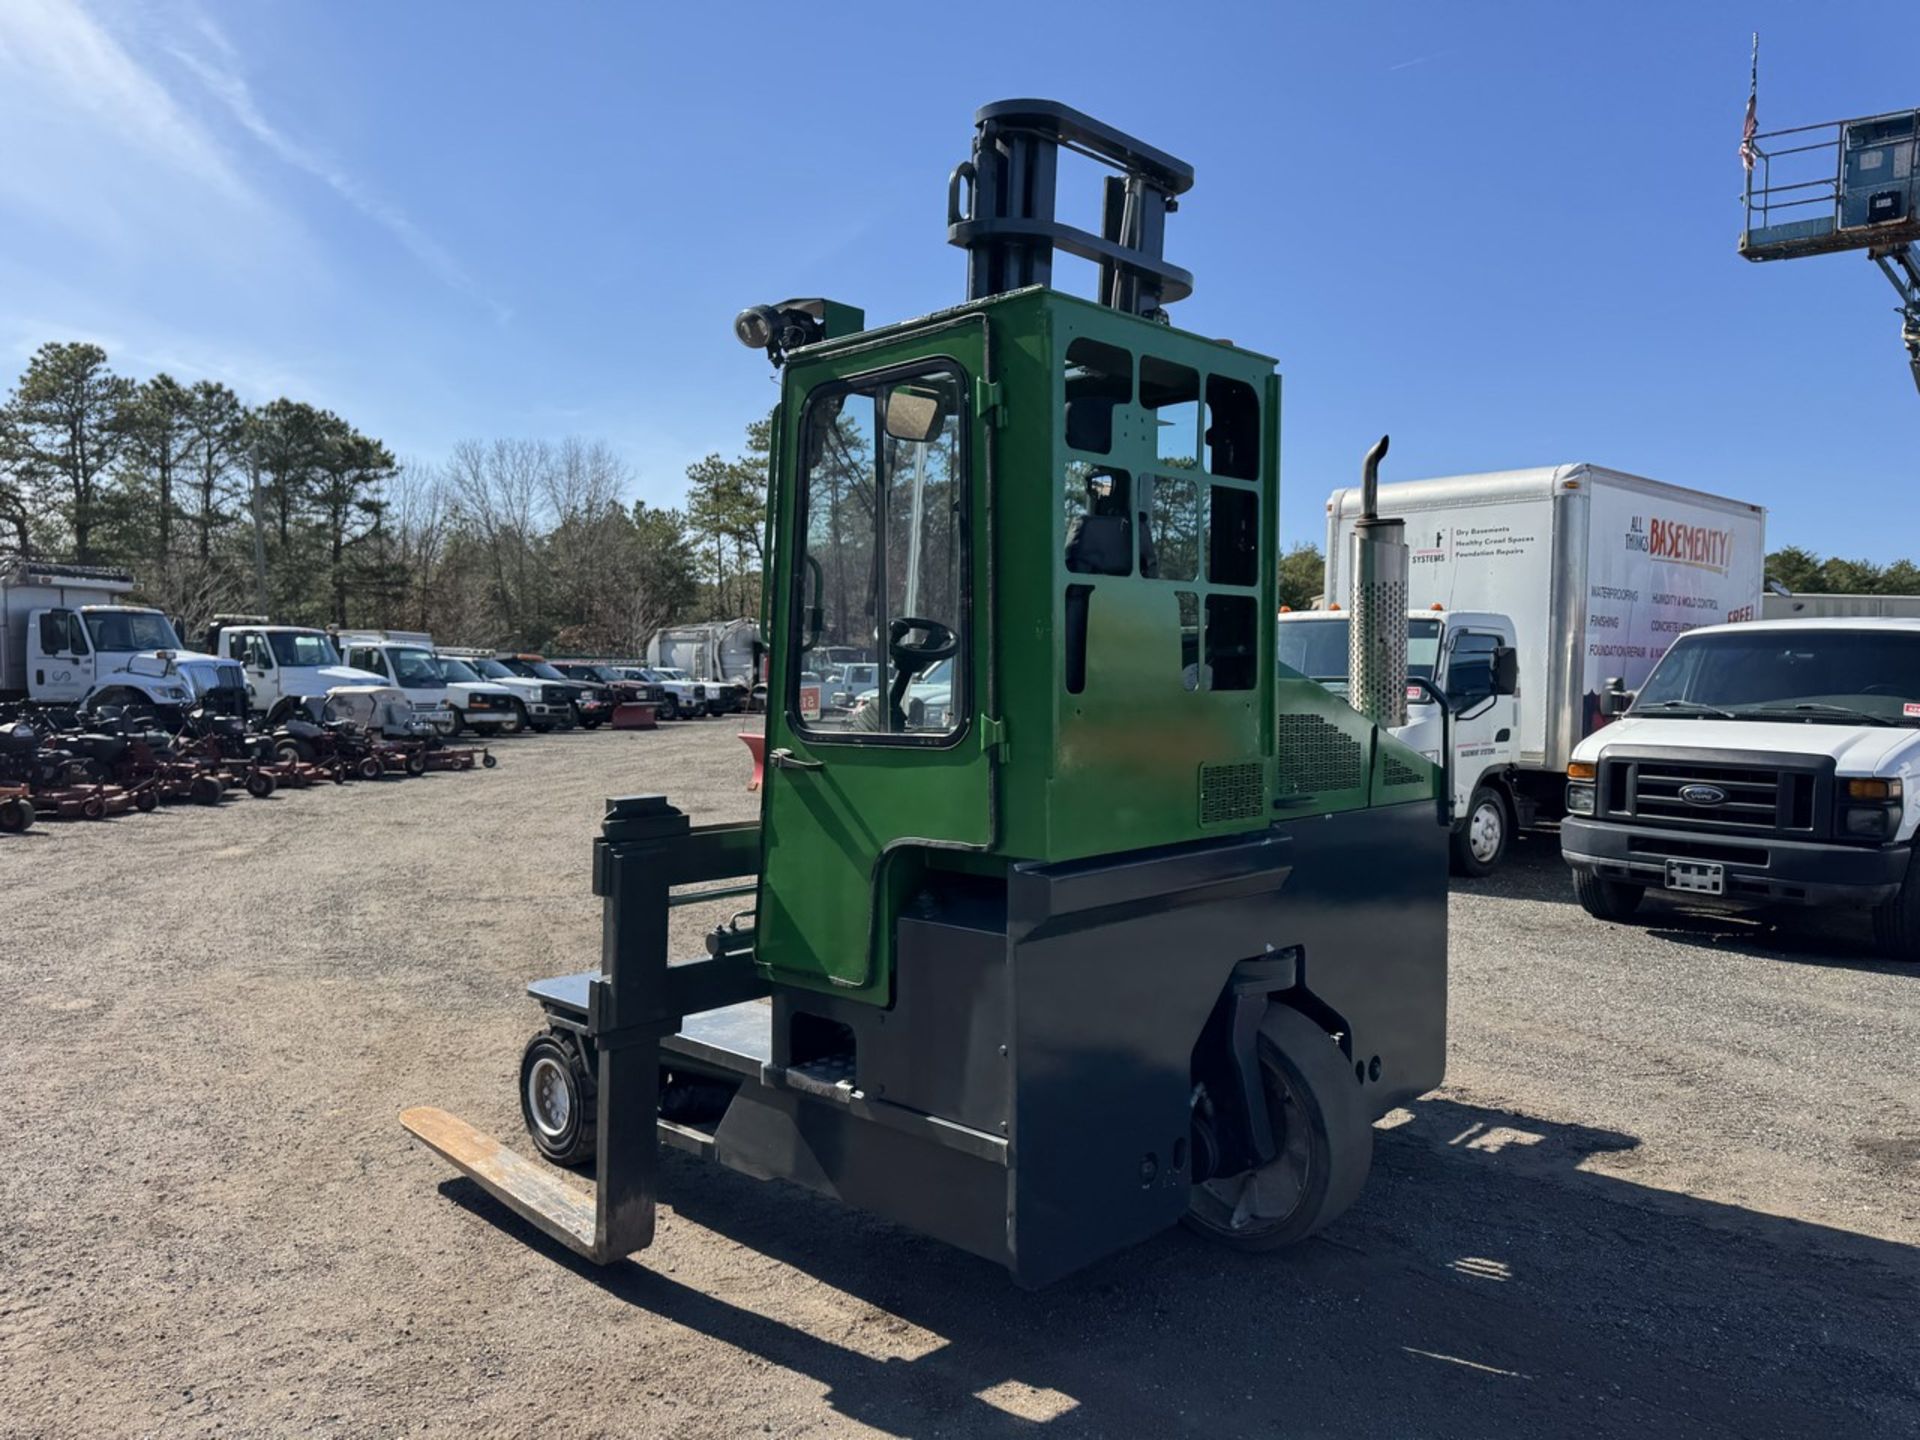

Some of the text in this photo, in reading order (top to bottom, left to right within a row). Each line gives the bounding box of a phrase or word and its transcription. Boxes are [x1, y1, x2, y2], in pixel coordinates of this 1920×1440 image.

[1630, 516, 1643, 533] ALL
[1456, 527, 1510, 536] Dry Basements
[1456, 539, 1483, 547] Healthy
[1507, 536, 1535, 544] Spaces
[1625, 533, 1649, 552] THINGS
[1412, 554, 1446, 564] SYSTEMS
[1455, 548, 1524, 558] Foundation Repairs
[1590, 614, 1619, 629] FINISHING
[1589, 644, 1626, 657] FOUNDATION
